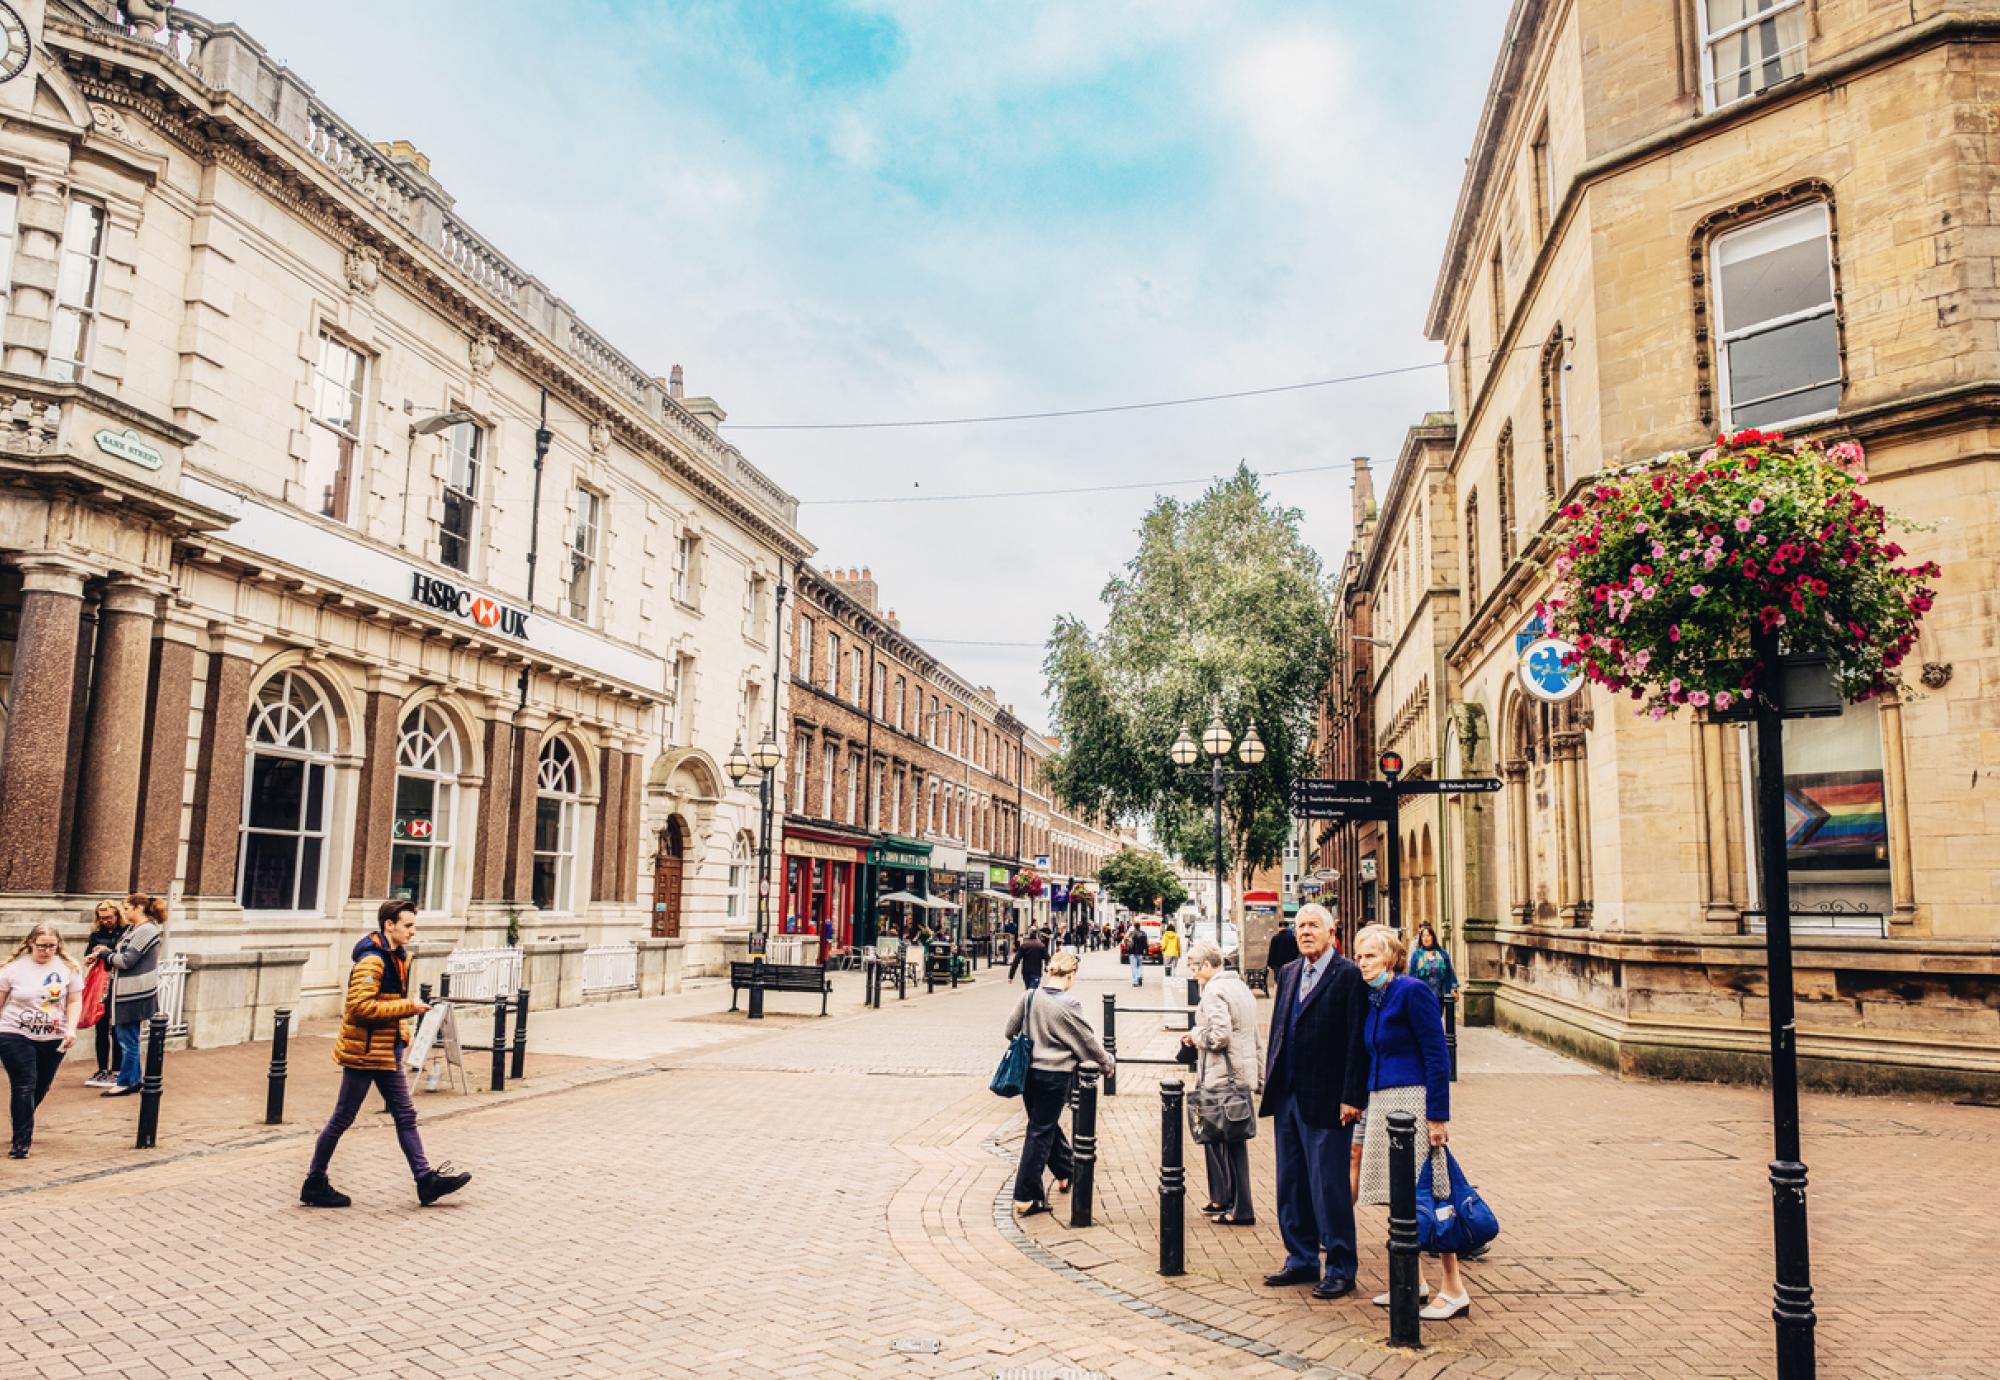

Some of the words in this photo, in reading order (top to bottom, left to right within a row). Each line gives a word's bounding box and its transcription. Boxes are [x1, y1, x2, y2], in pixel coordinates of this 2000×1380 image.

[102, 435, 125, 450] BANK
[127, 446, 158, 463] STREET
[411, 572, 470, 617] HSBC
[501, 606, 530, 640] UK
[19, 1009, 52, 1024] GRL
